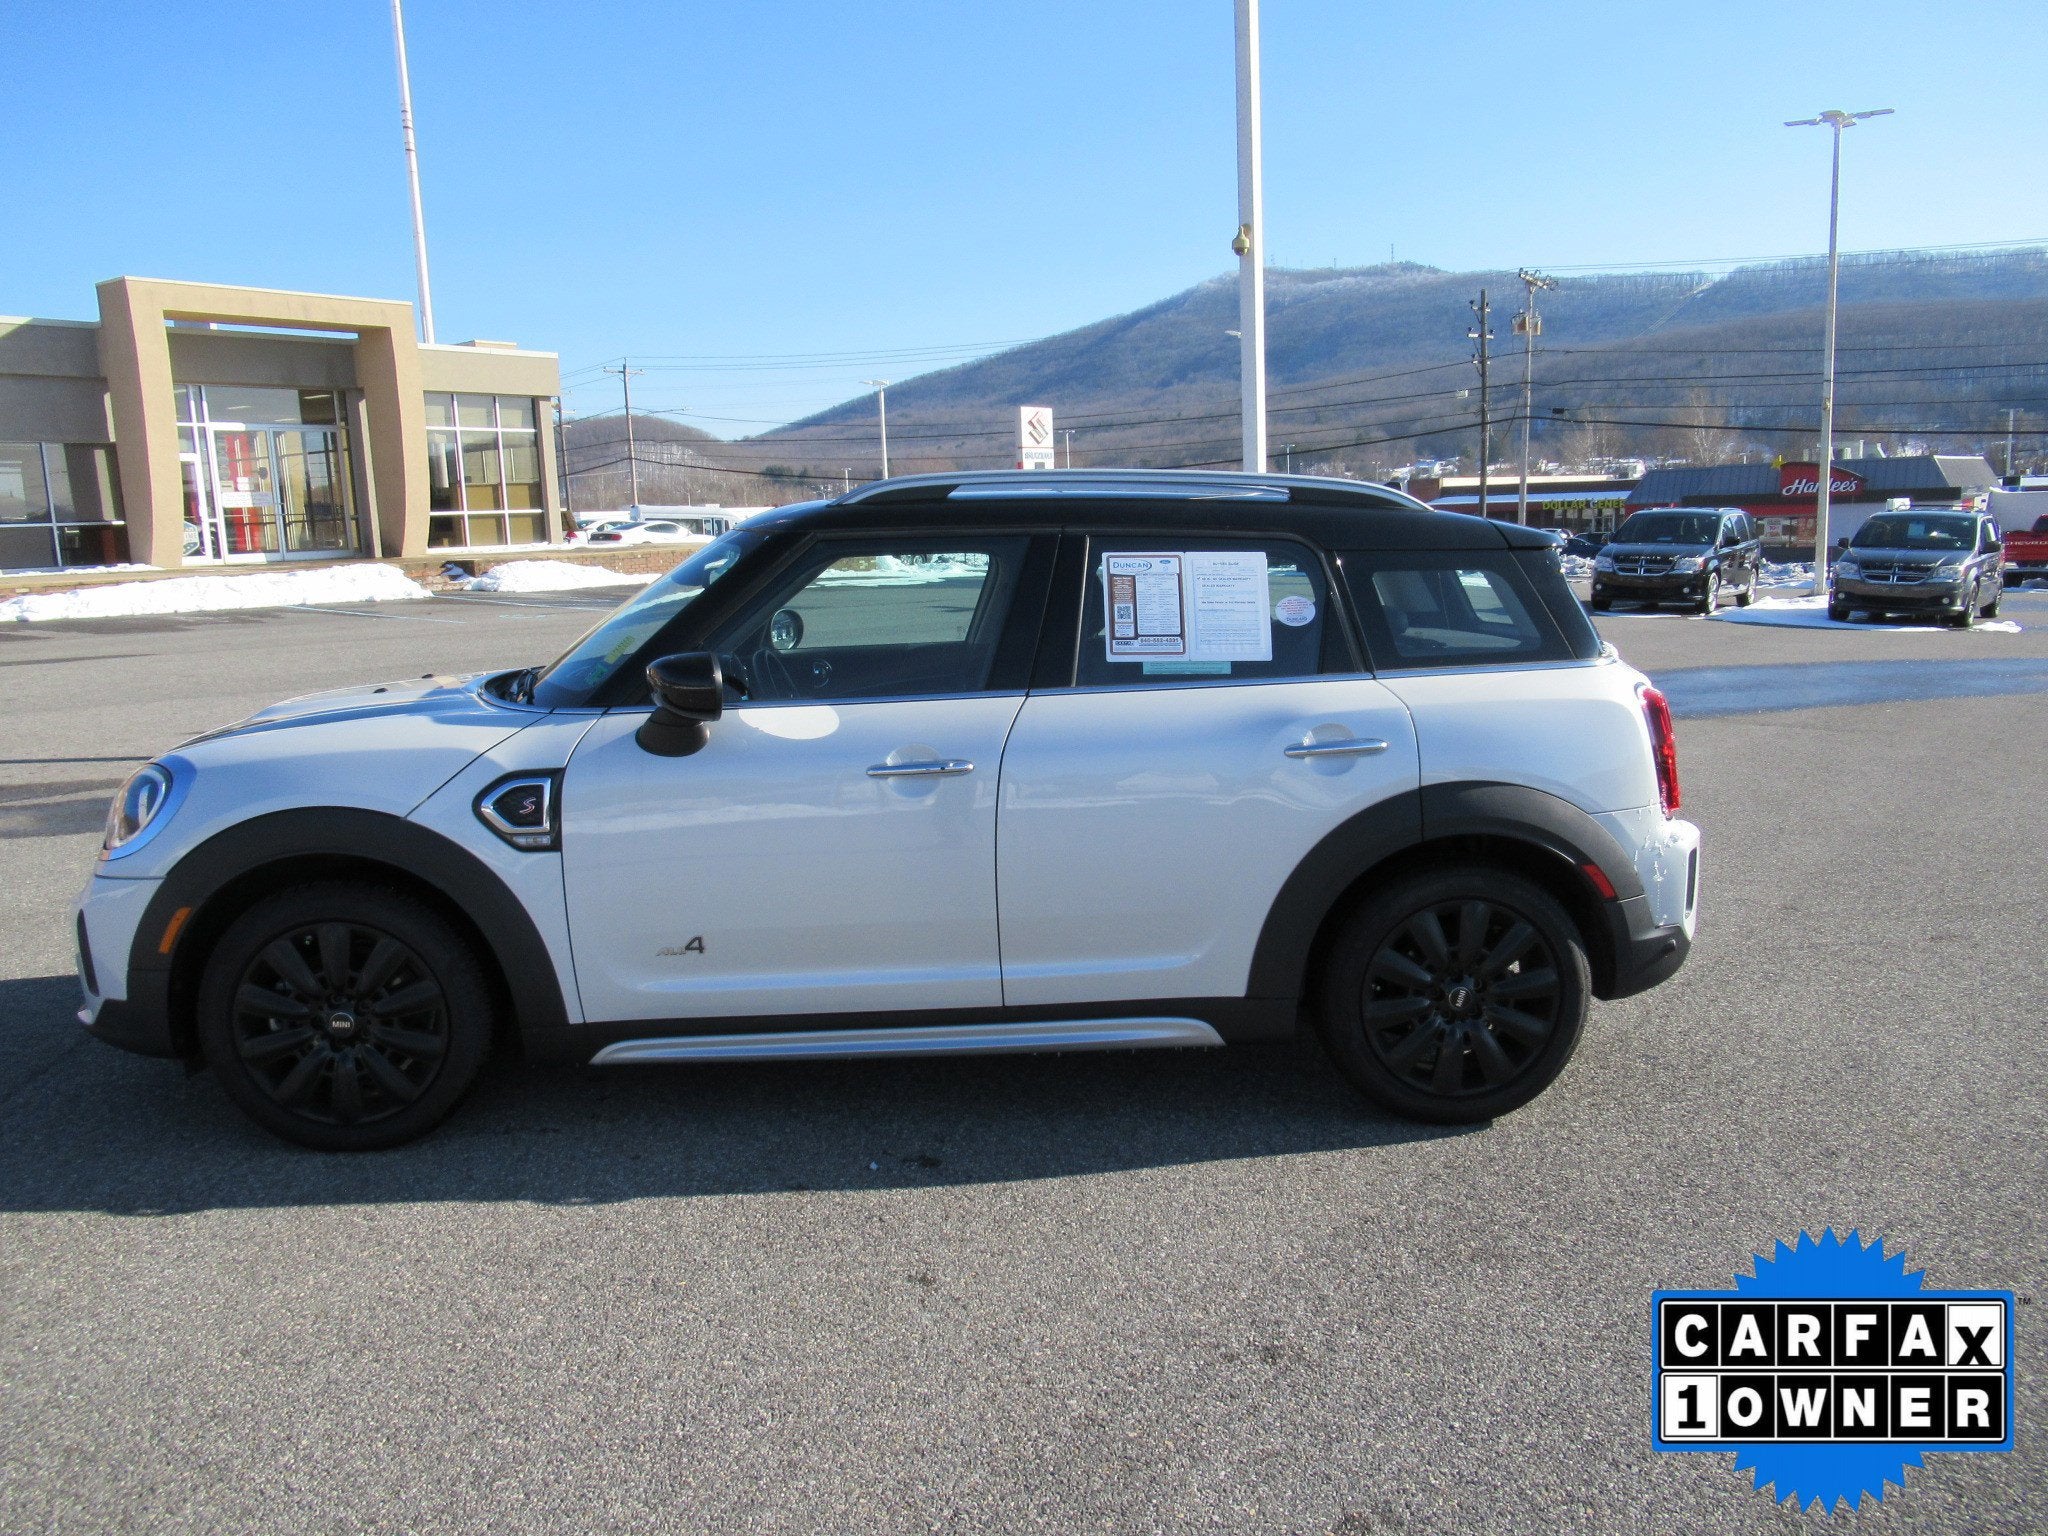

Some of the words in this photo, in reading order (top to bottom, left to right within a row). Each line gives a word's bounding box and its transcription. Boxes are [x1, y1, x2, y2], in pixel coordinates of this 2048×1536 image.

[1782, 478, 1858, 496] Haree's
[1542, 500, 1587, 510] DOLLAR
[1113, 561, 1149, 569] DUNCAN
[519, 796, 536, 814] S
